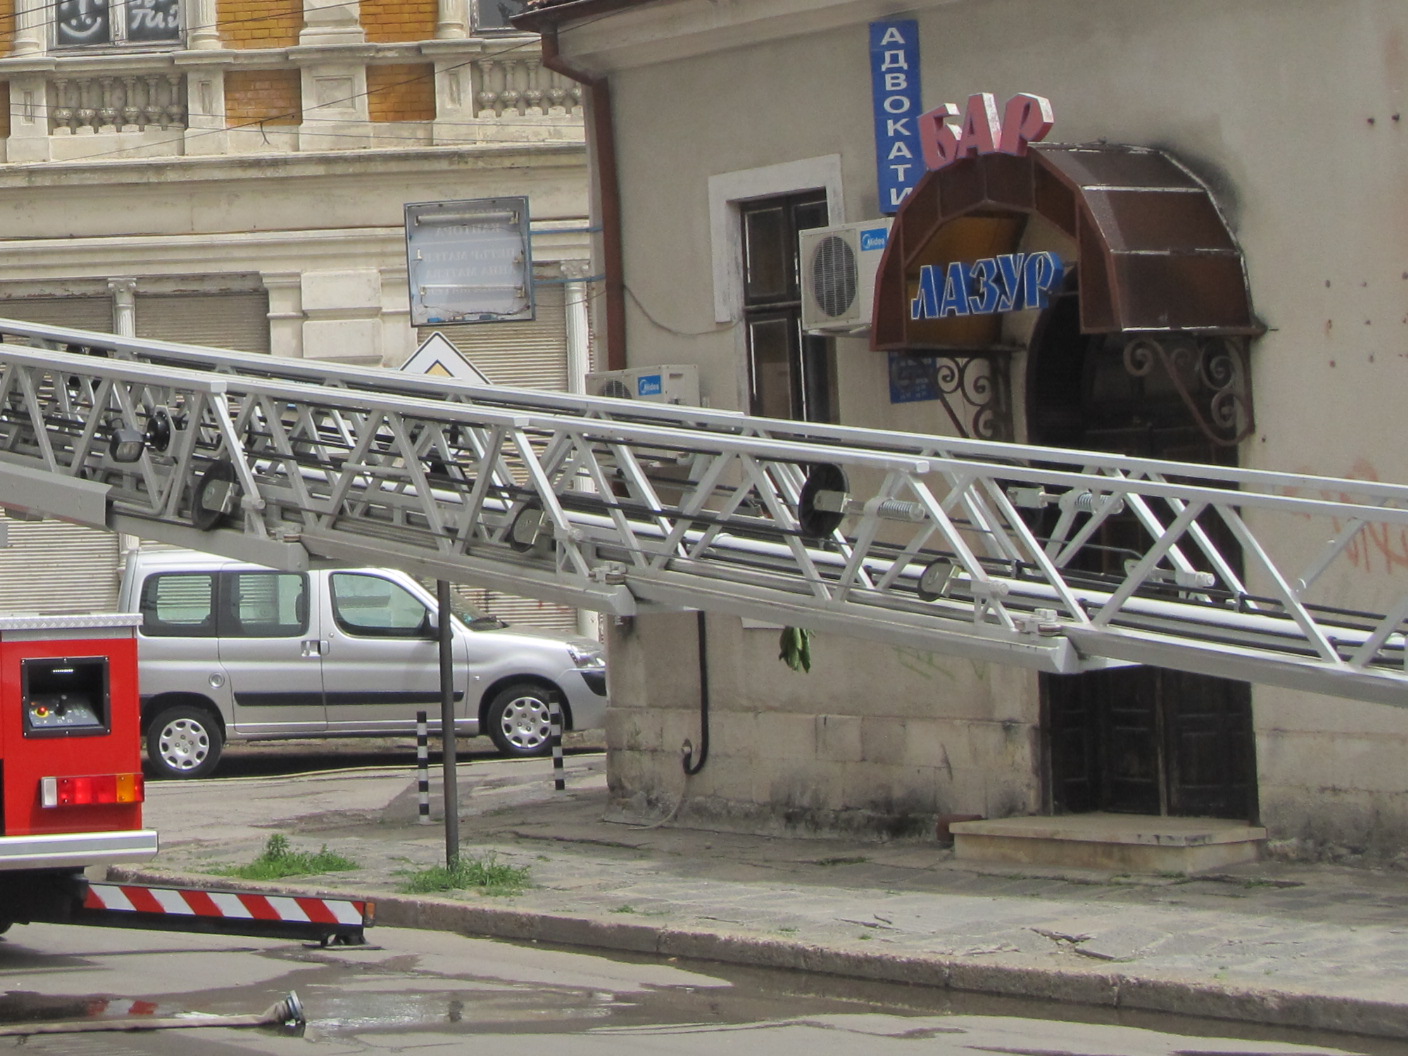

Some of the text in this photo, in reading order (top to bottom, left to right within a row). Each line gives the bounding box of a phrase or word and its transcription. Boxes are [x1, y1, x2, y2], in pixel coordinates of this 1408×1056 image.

[880, 27, 914, 206] АДВОКАТИ
[917, 92, 1054, 172] БАР
[910, 251, 1059, 320] ЛАЗУР
